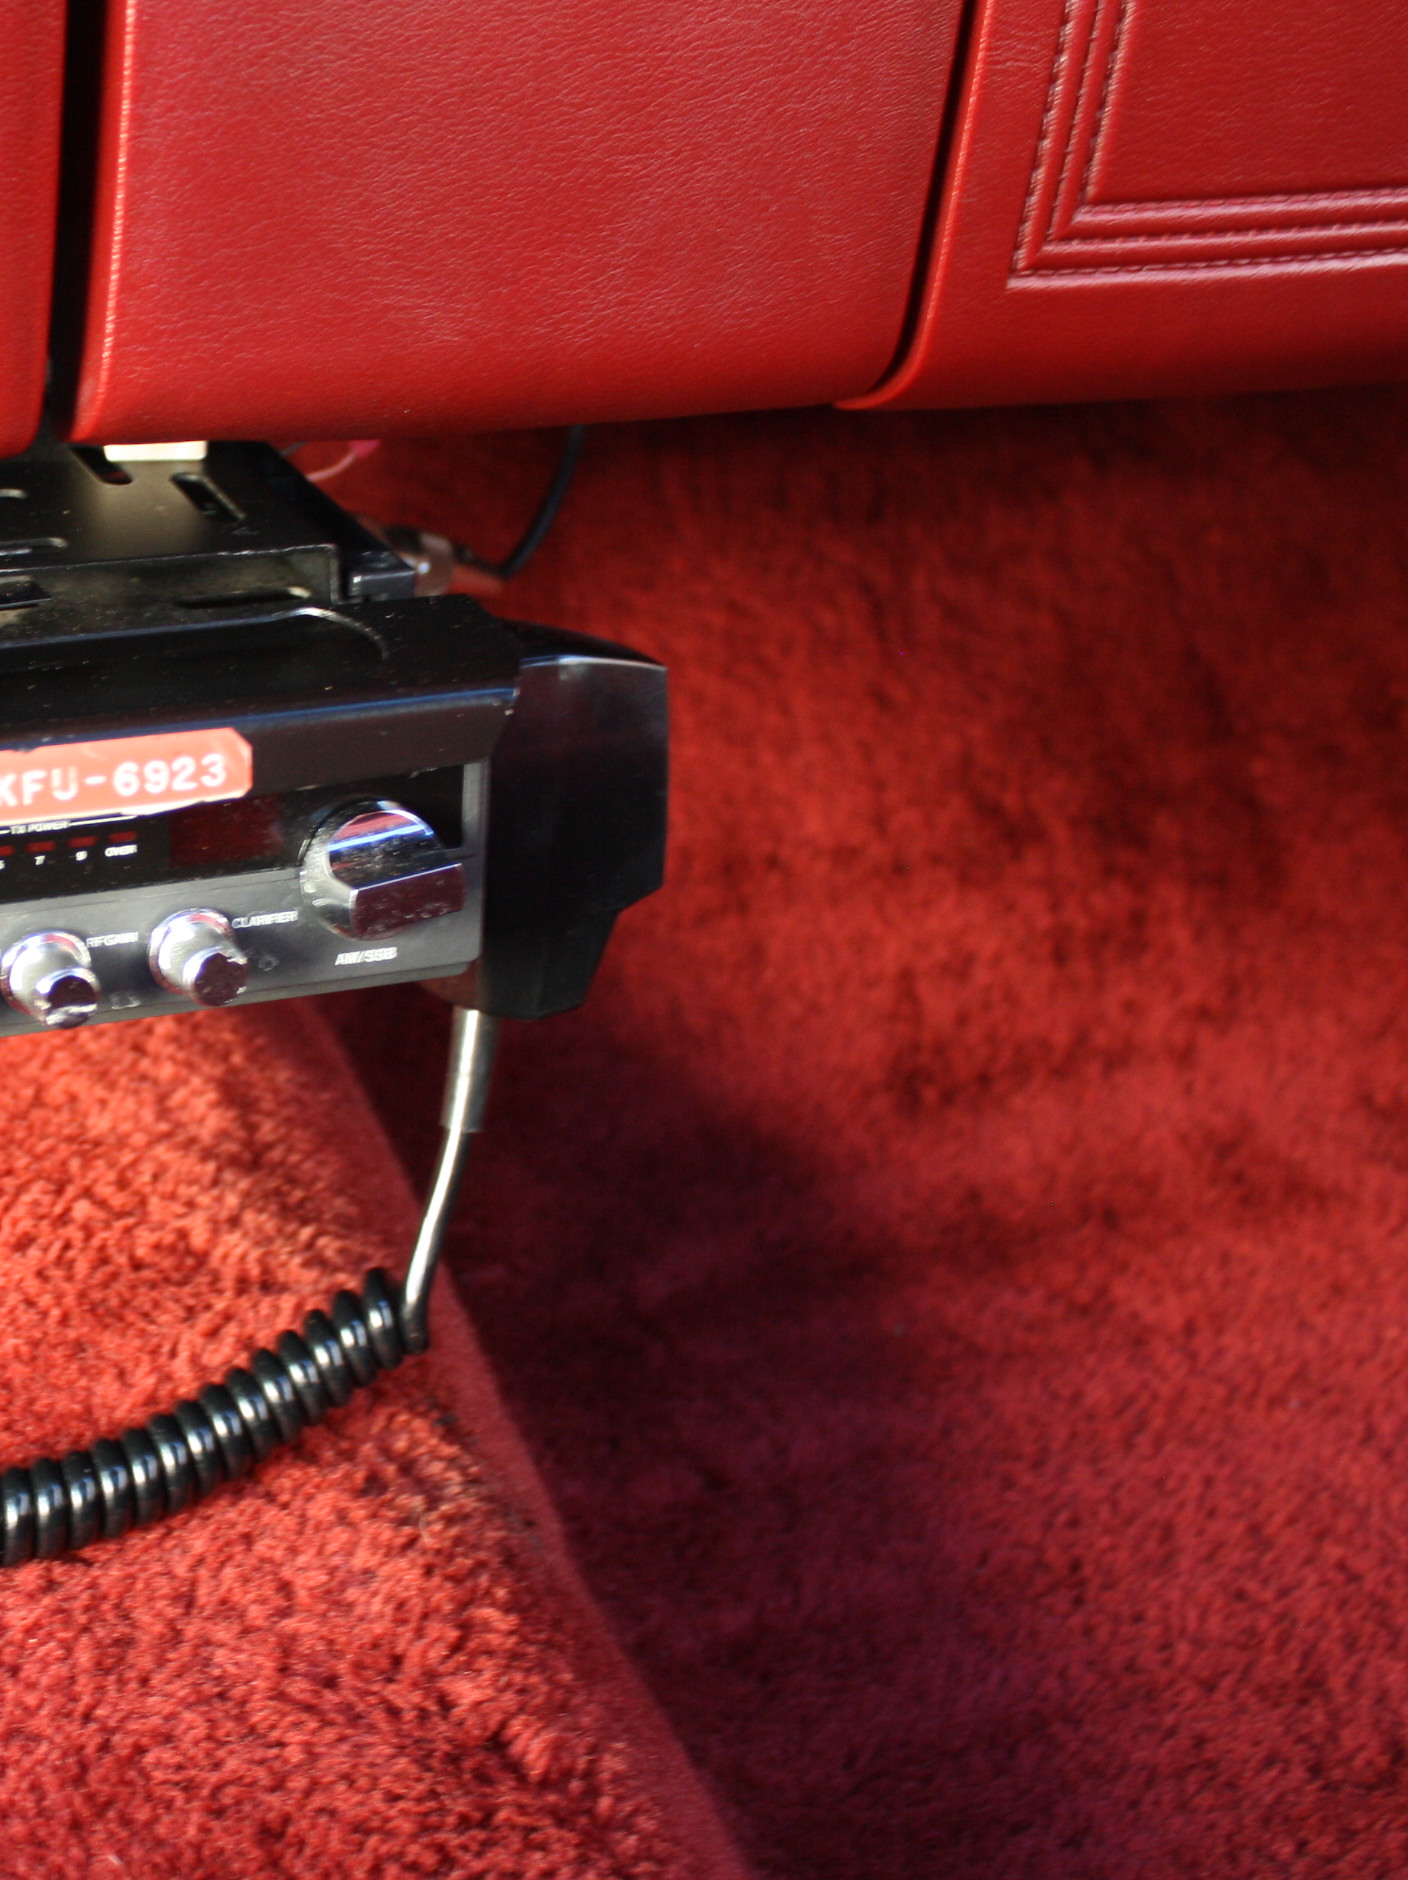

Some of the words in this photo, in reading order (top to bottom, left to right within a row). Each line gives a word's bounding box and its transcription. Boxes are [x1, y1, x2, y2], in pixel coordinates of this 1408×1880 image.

[27, 820, 70, 833] POWER
[35, 855, 45, 866] 7
[232, 911, 298, 928] CLARIFIER
[335, 947, 398, 966] AM/SSB
